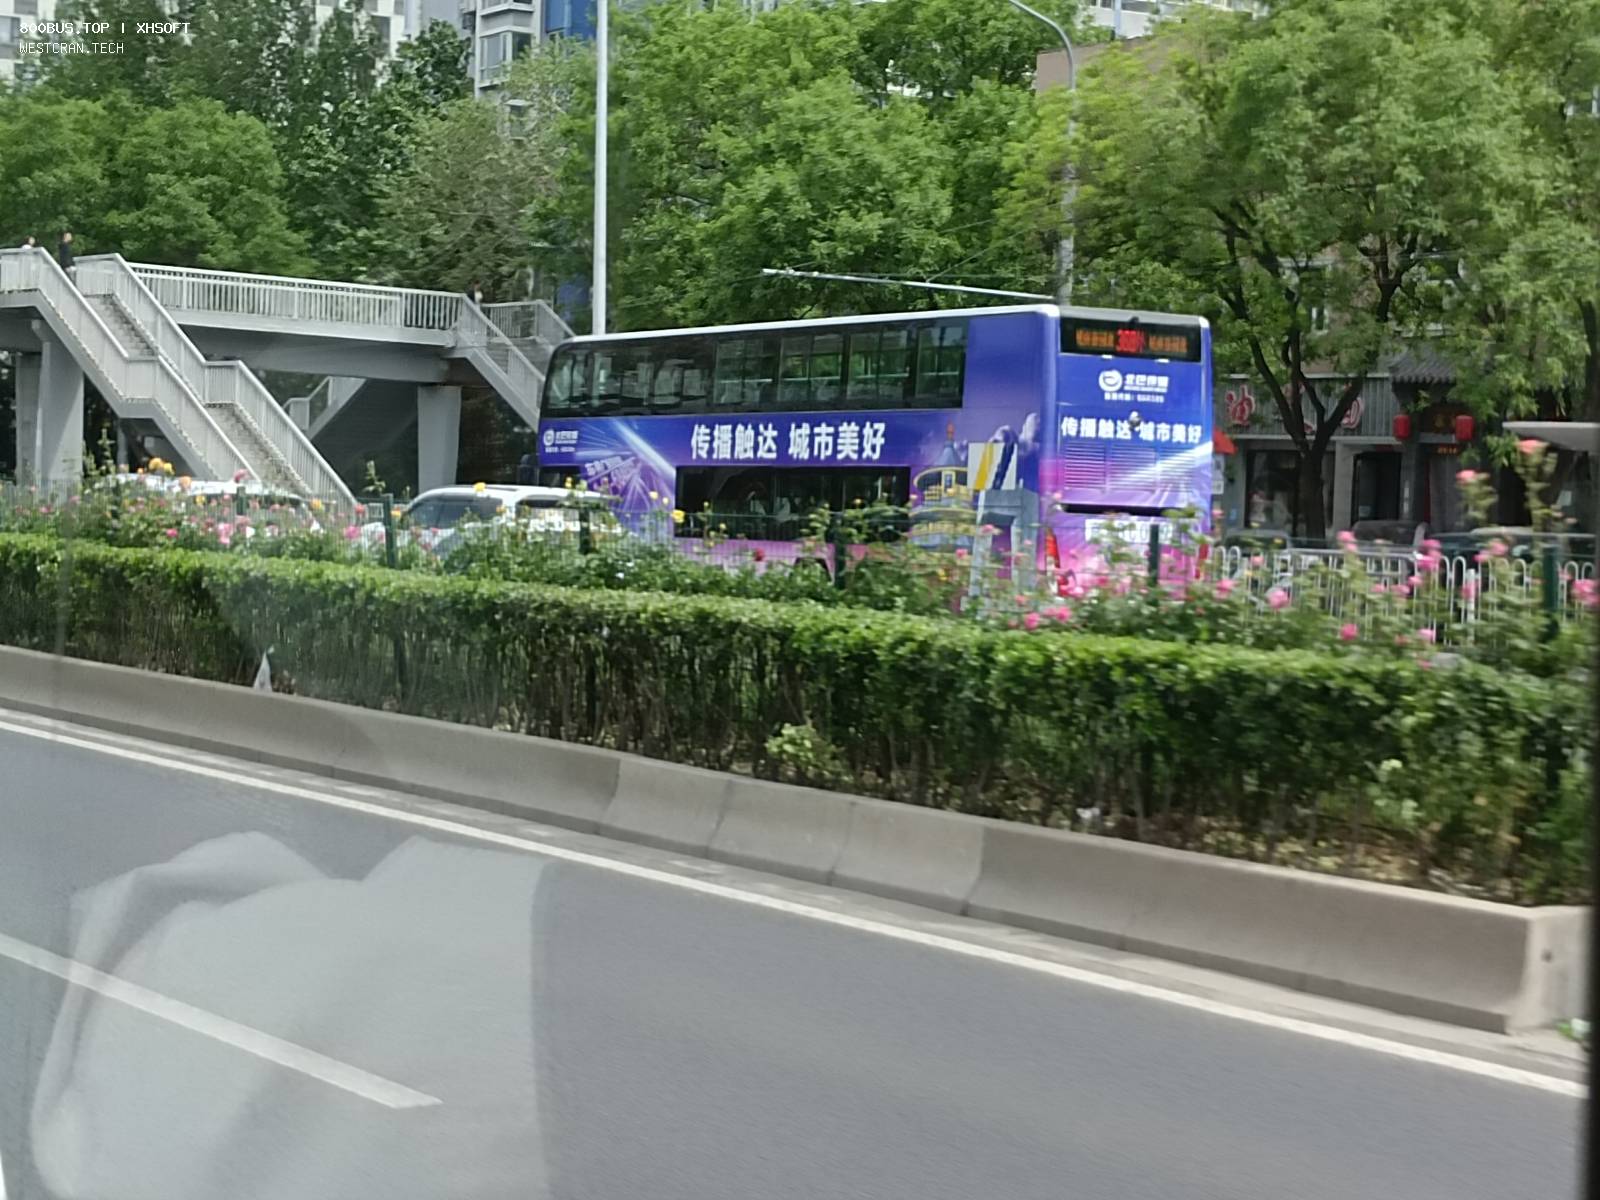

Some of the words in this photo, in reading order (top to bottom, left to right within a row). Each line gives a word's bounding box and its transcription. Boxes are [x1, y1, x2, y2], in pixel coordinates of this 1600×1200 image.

[691, 423, 778, 460] 传播触达
[788, 421, 886, 460] 城市美好
[1061, 416, 1132, 440] 传播触达
[1139, 421, 1202, 444] 城市美好
